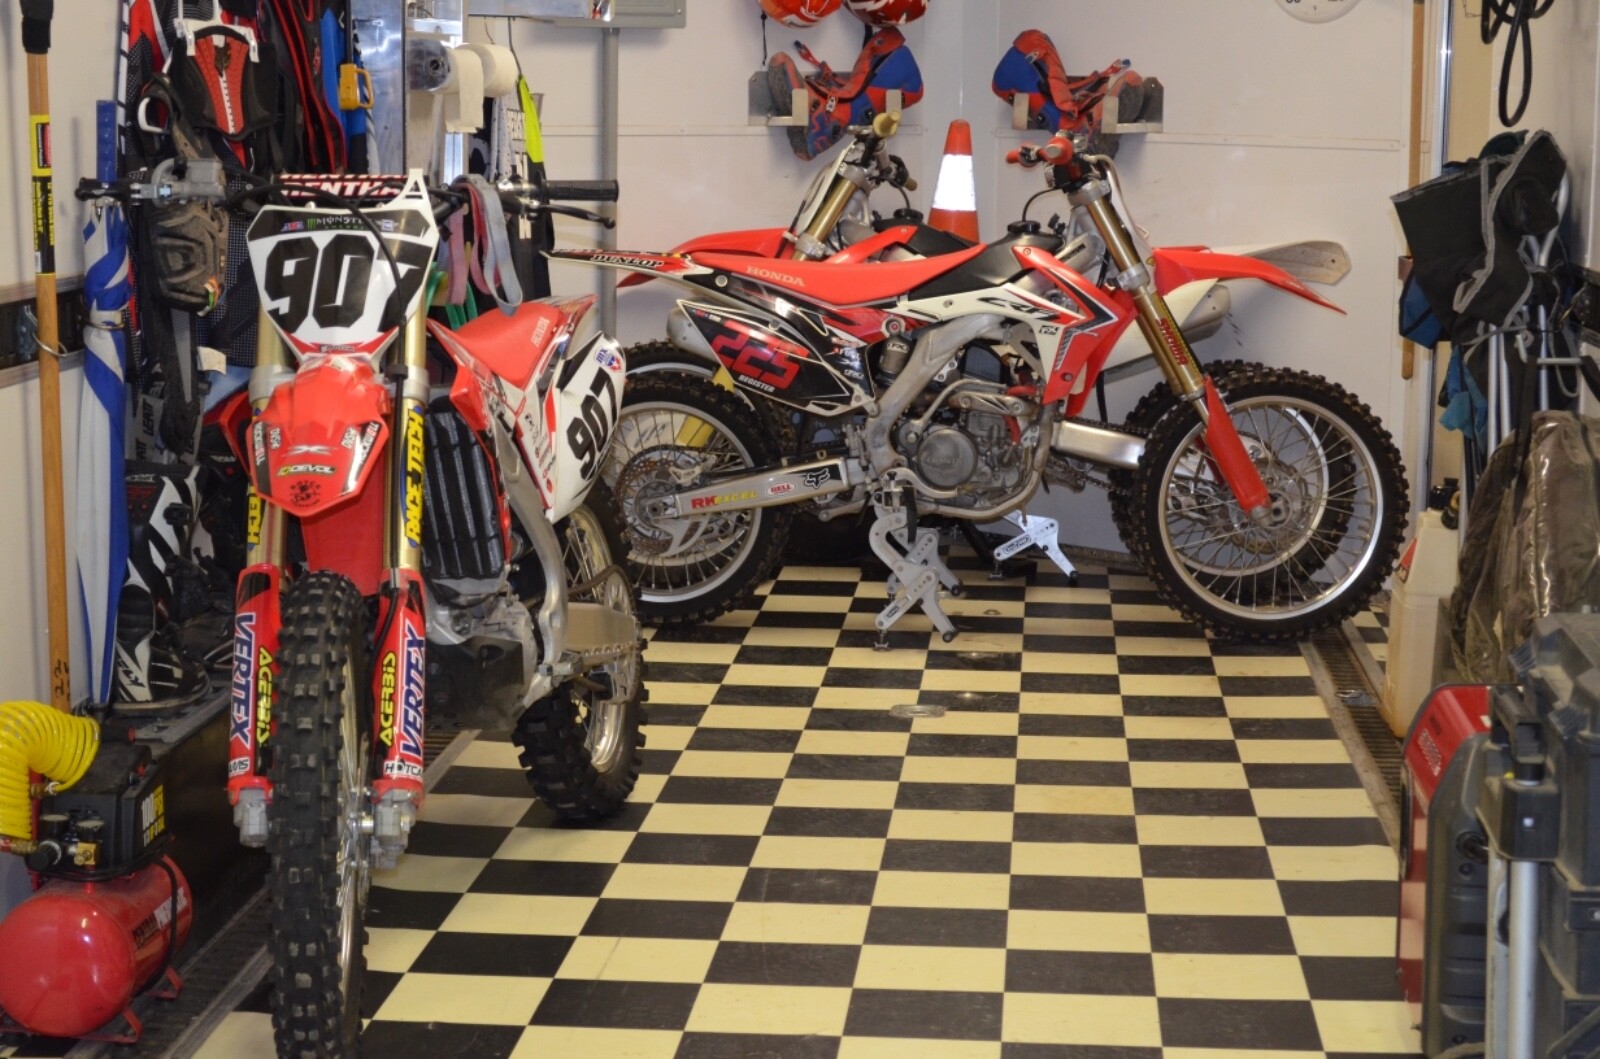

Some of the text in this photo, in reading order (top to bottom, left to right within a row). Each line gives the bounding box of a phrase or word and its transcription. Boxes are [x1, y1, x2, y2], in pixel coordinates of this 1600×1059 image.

[264, 234, 434, 334] 907
[591, 254, 665, 268] DUNLOP
[746, 265, 805, 287] HONDA
[738, 374, 776, 393] REGISTER
[566, 366, 619, 481] 907
[406, 477, 424, 543] RACE
[691, 496, 717, 508] RK
[229, 612, 256, 751] VERTEX
[400, 619, 425, 759] VERTEX
